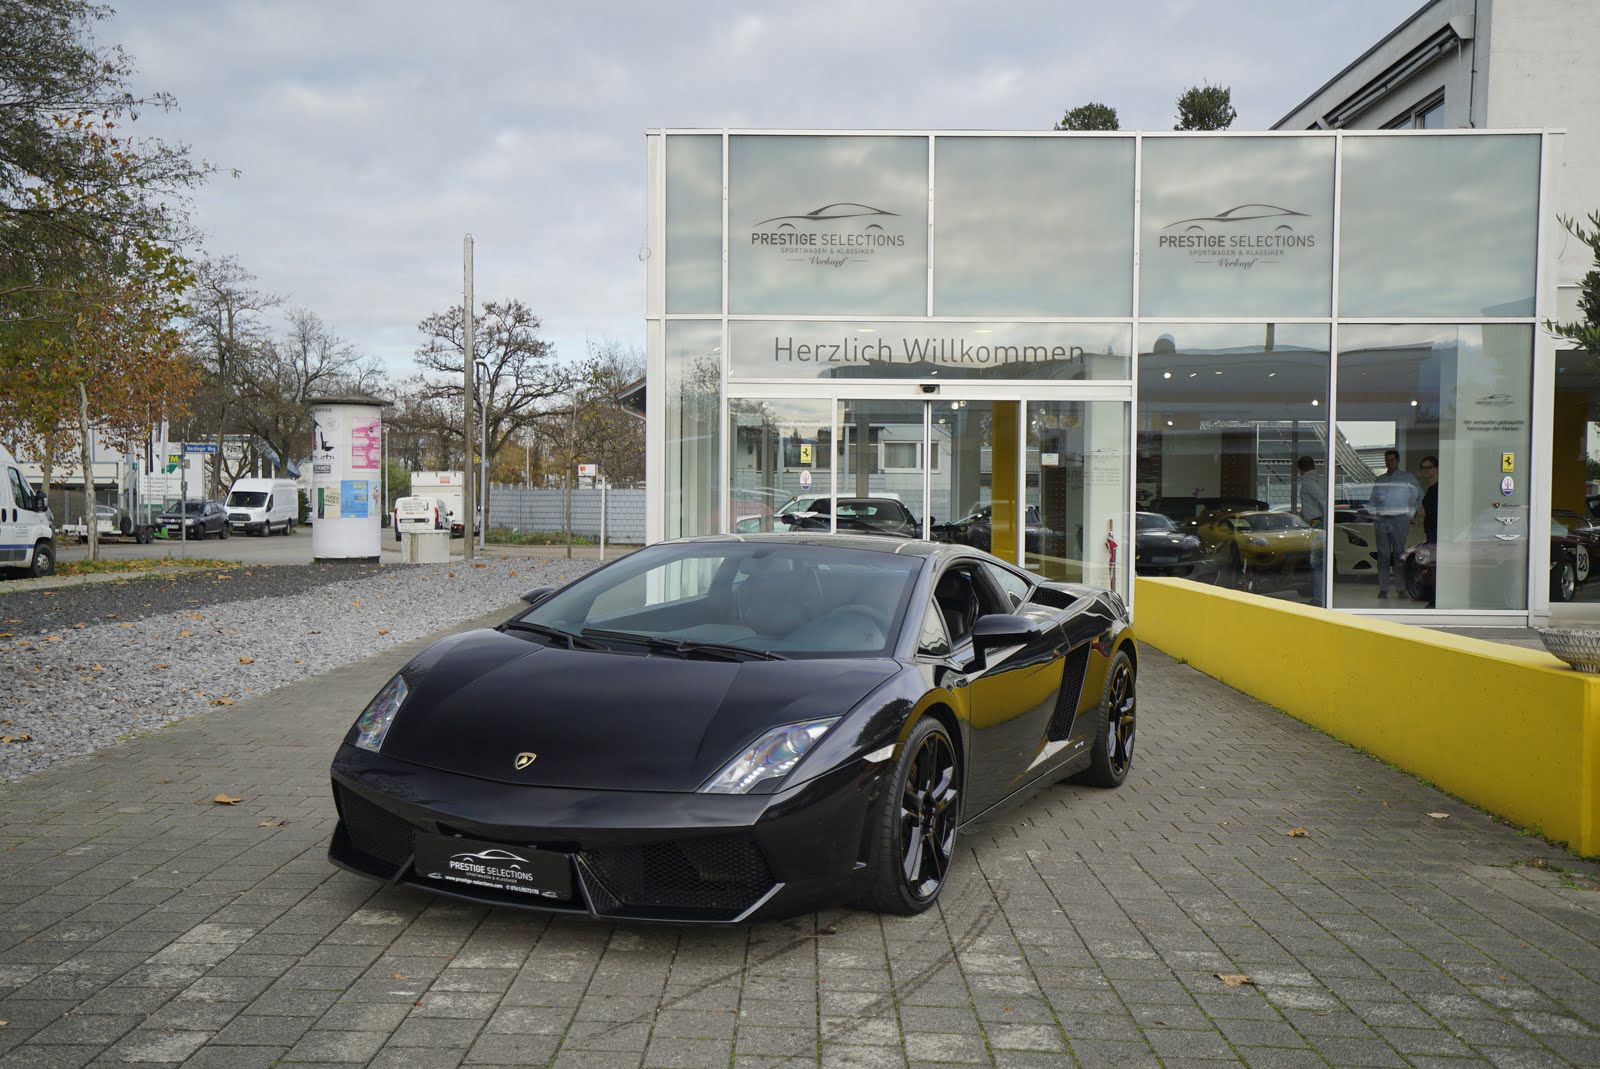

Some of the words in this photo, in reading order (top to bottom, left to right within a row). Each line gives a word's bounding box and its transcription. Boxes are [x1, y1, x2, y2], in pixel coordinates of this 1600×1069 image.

[751, 233, 817, 246] PRESTIGE
[821, 234, 905, 247] SELECTIONS
[1159, 235, 1226, 248] PRESTIGE
[1229, 235, 1315, 248] SELECTIONS
[809, 256, 849, 268] Verkauf
[1217, 258, 1258, 270] Verkauf
[774, 337, 893, 362] Herzlich
[902, 337, 1086, 363] Willkommen
[1578, 553, 1588, 572] 23
[450, 861, 486, 873] PRESTIGE
[486, 866, 534, 881] SELECTIONS
